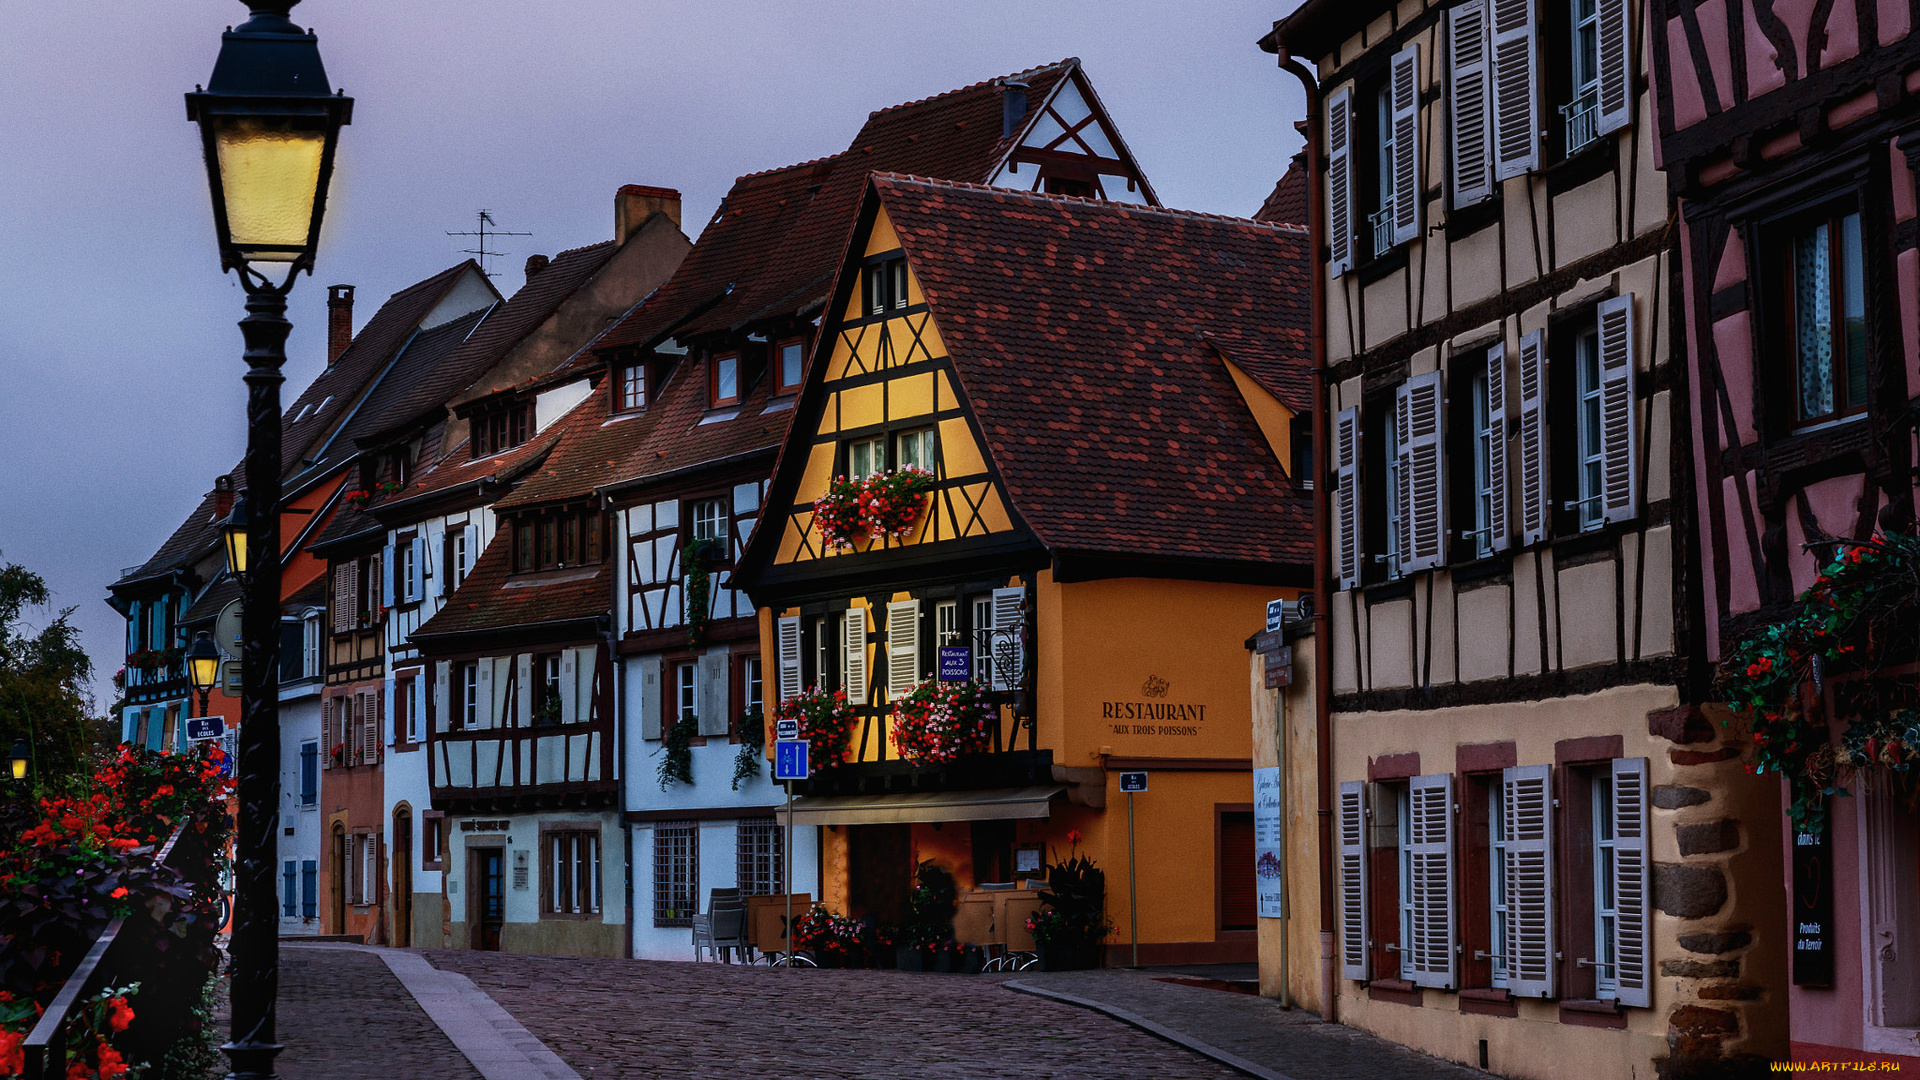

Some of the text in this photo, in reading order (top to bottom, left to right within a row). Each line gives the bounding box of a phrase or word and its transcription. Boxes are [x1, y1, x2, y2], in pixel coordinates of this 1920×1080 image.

[958, 658, 965, 666] 3
[1102, 701, 1206, 721] RESTAURANT
[1132, 725, 1156, 735] TROIS
[1797, 831, 1814, 846] dans
[1799, 922, 1821, 934] Produits
[1797, 938, 1822, 950] du Terroir
